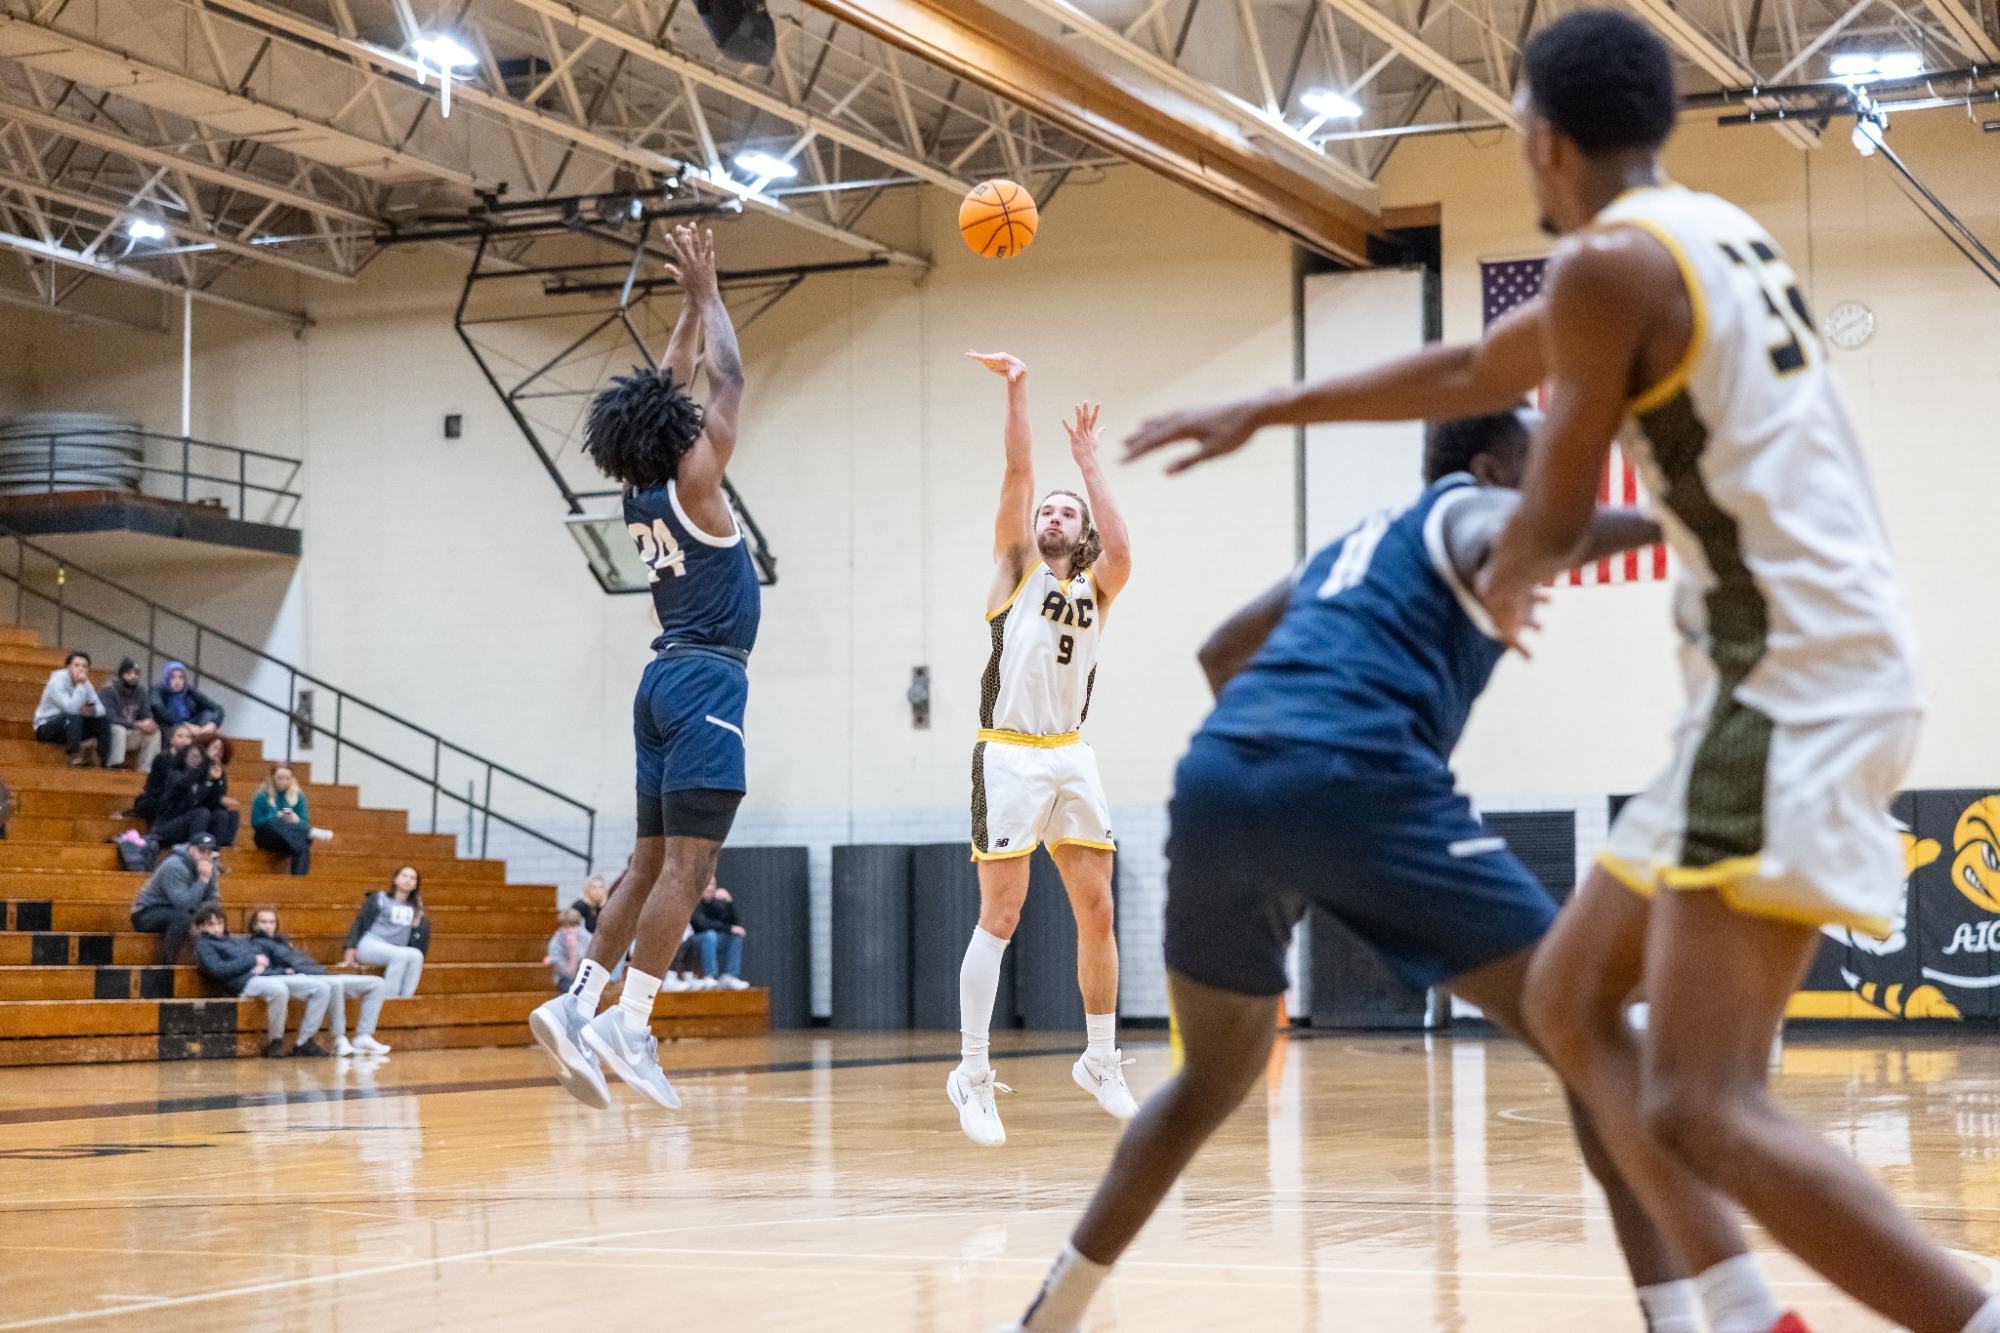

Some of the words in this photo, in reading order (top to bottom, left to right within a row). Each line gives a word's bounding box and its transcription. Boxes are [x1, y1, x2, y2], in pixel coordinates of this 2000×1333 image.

[628, 518, 686, 583] 24
[1041, 590, 1094, 630] AIC
[1057, 634, 1075, 665] 9
